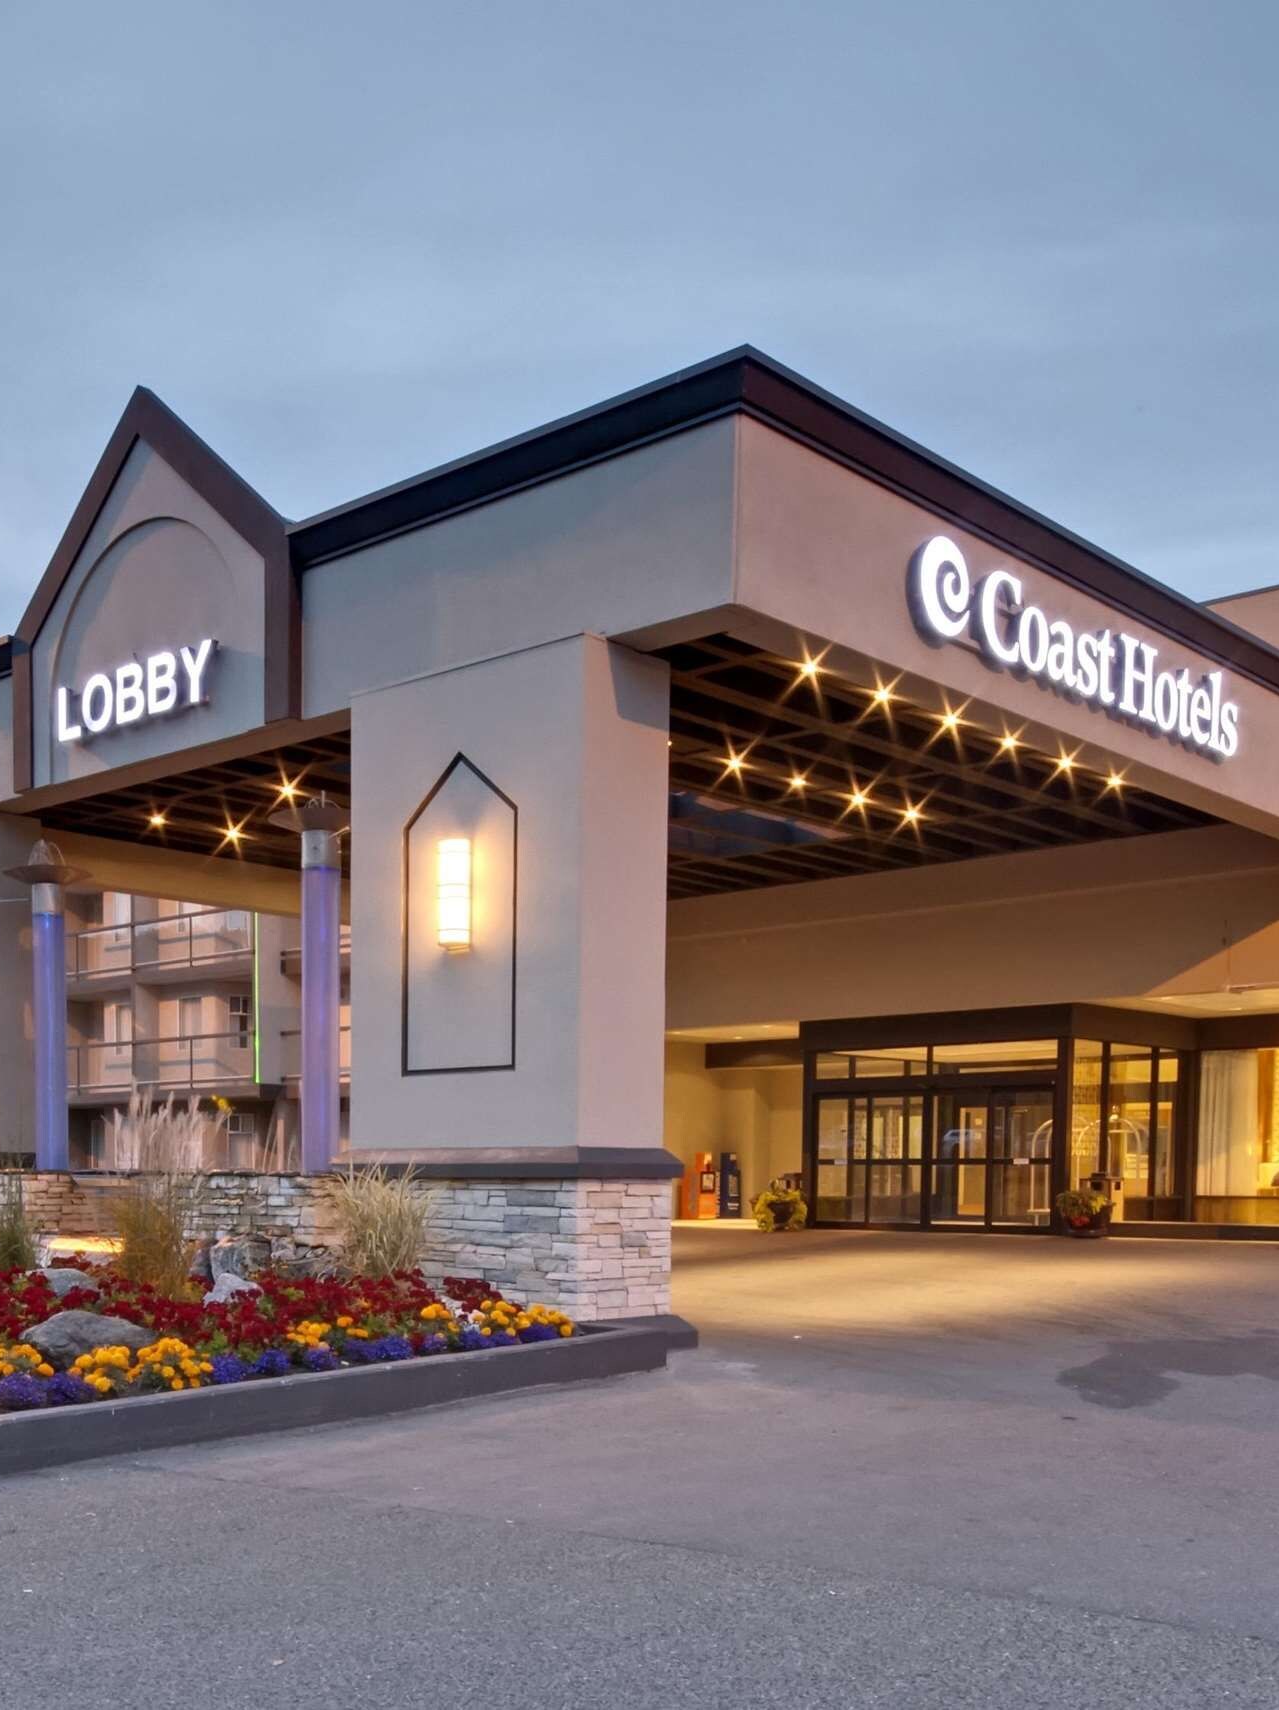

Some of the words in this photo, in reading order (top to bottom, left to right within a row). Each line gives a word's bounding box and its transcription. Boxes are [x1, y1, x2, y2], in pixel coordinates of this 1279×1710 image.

[57, 639, 212, 742] LOBBY
[982, 570, 1115, 702] Coast
[1119, 632, 1239, 757] Hotels
